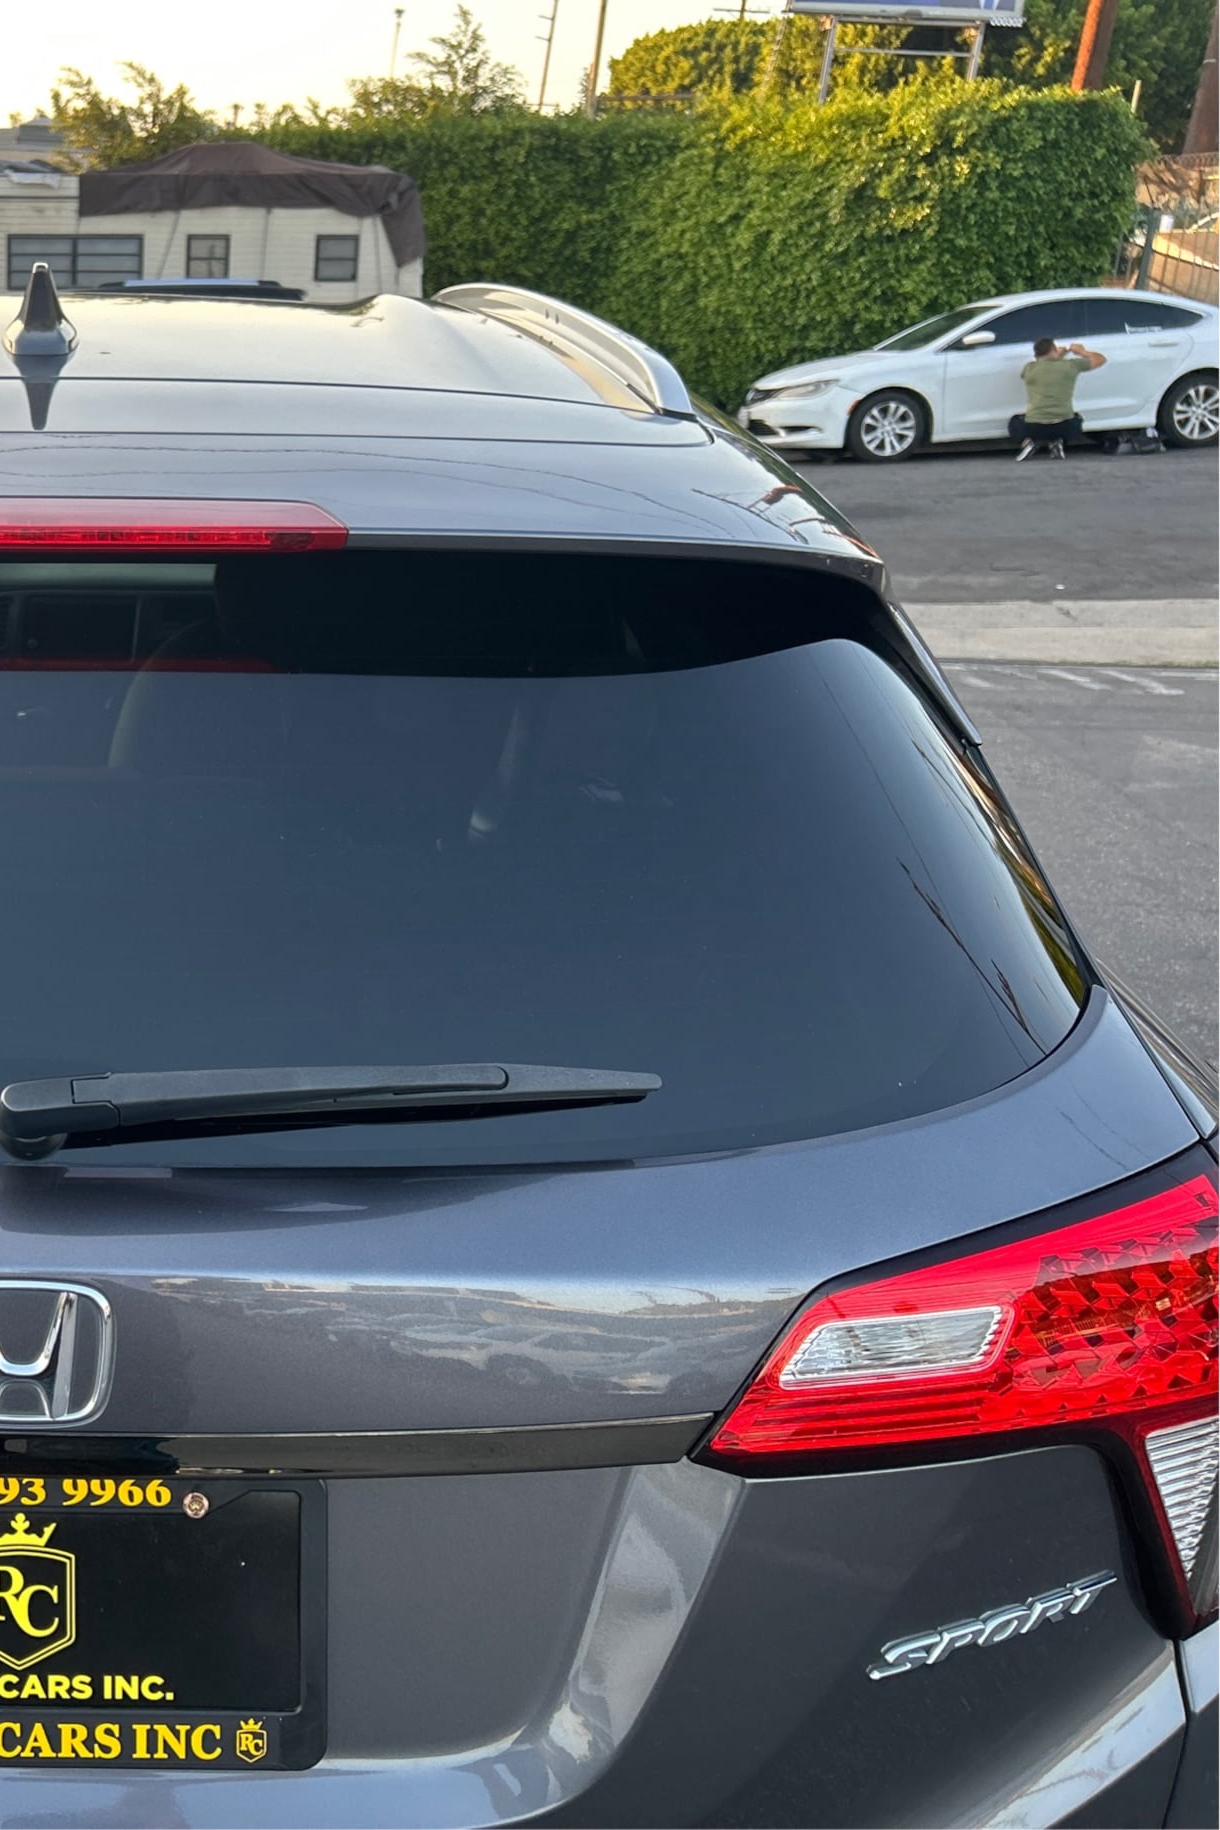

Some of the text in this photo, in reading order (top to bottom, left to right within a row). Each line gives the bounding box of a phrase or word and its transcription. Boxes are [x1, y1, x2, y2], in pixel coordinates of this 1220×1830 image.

[62, 1478, 171, 1507] 9966
[866, 1569, 1118, 1680] SPORT
[103, 1675, 175, 1701] INC.
[132, 1724, 222, 1761] INC
[240, 1733, 264, 1756] RC
